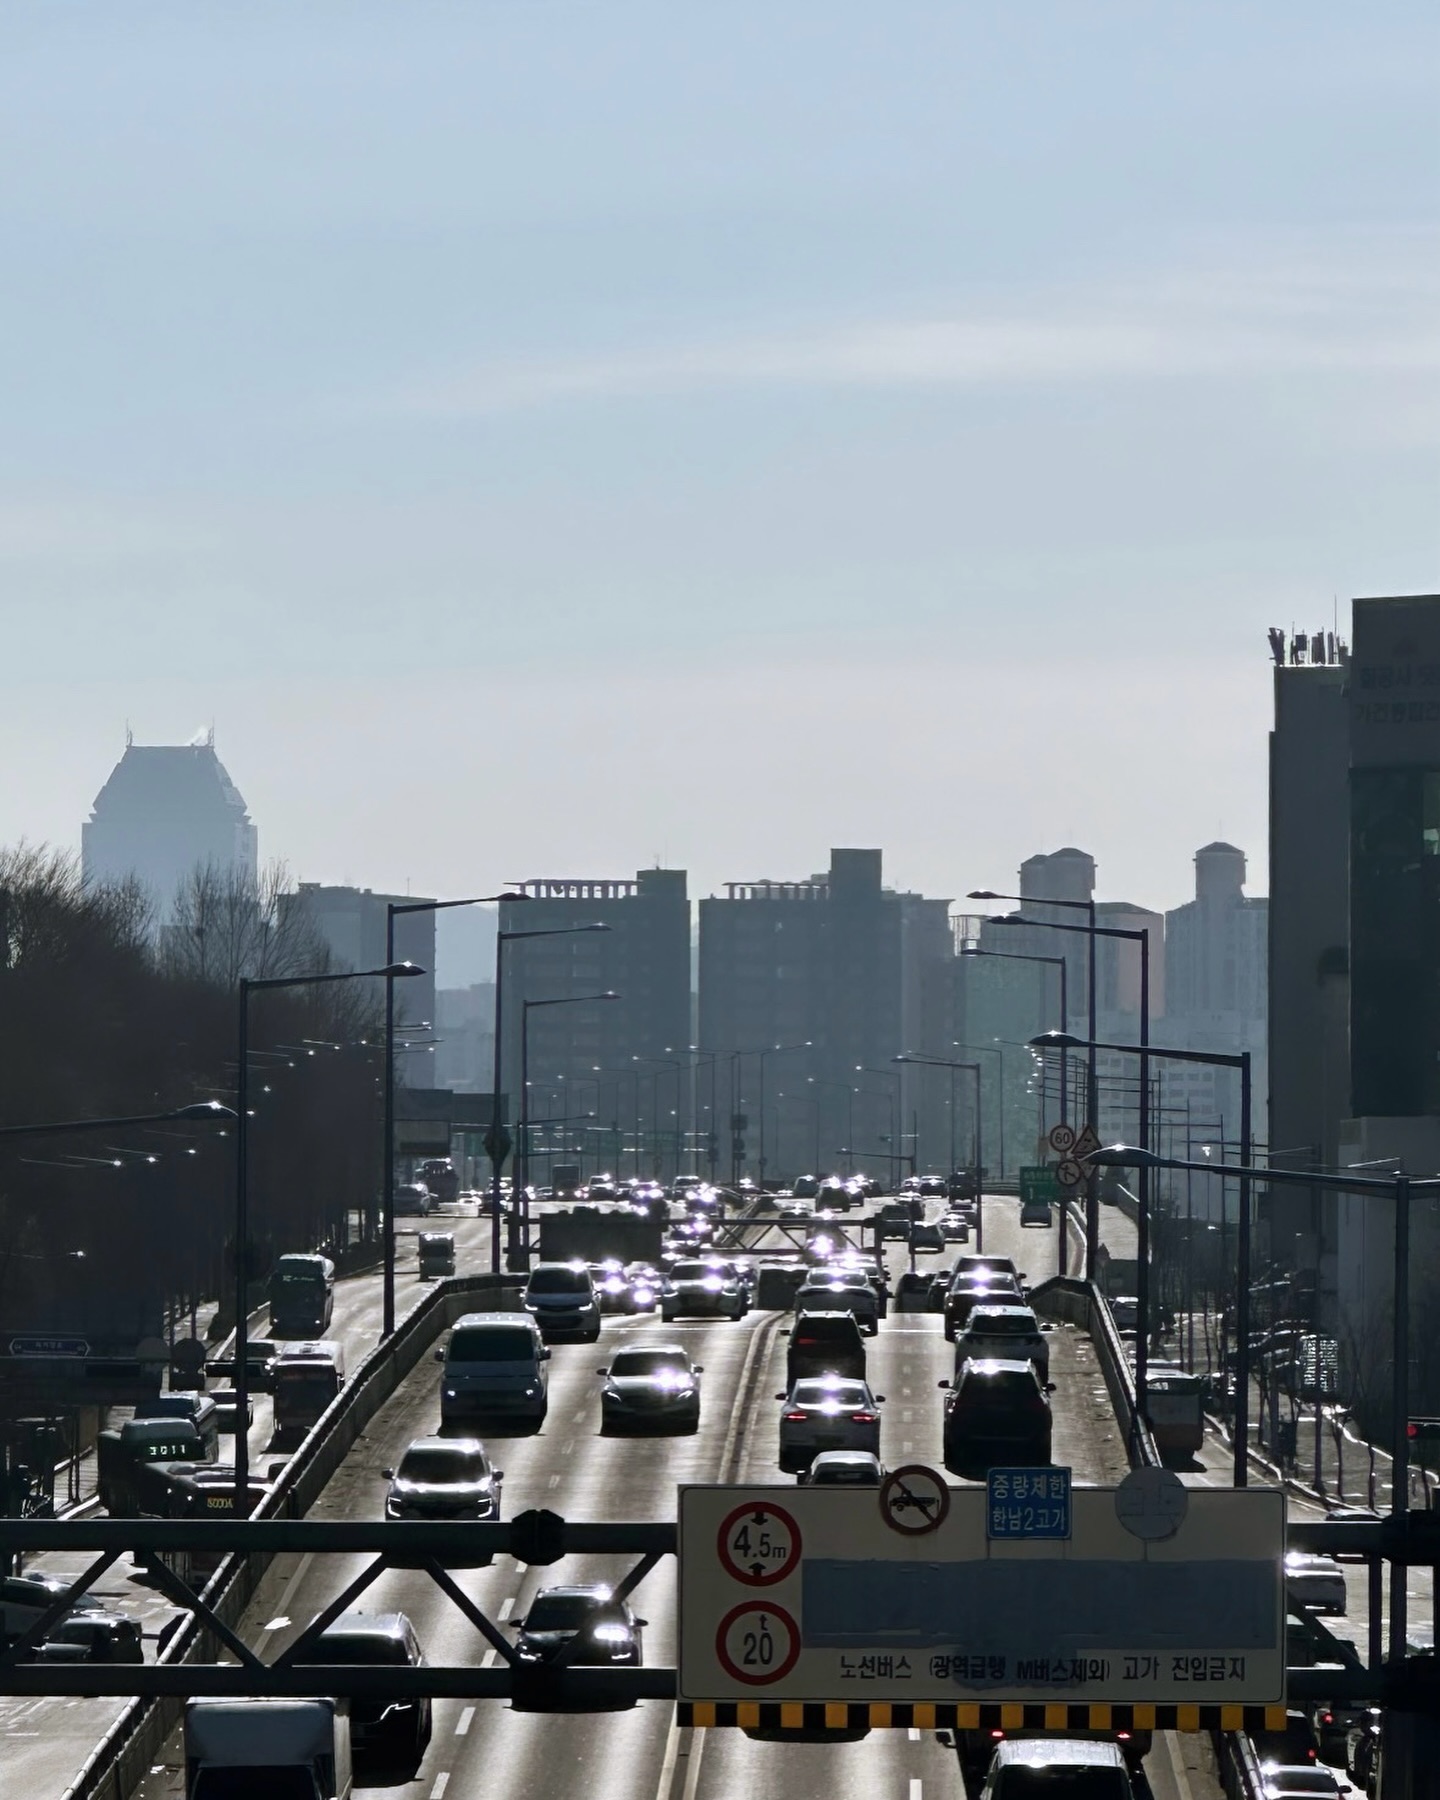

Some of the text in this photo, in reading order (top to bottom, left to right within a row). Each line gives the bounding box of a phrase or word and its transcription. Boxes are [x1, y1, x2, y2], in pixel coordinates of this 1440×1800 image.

[1054, 1132, 1070, 1144] 60
[992, 1474, 1066, 1500] 중량제한
[992, 1506, 1066, 1531] 한남2고가
[733, 1525, 786, 1558] 4.5m
[759, 1614, 768, 1631] t
[743, 1632, 773, 1665] 20
[839, 1655, 912, 1680] 노선버스
[1122, 1656, 1160, 1681] 고가
[1171, 1656, 1246, 1682] 진입금지
